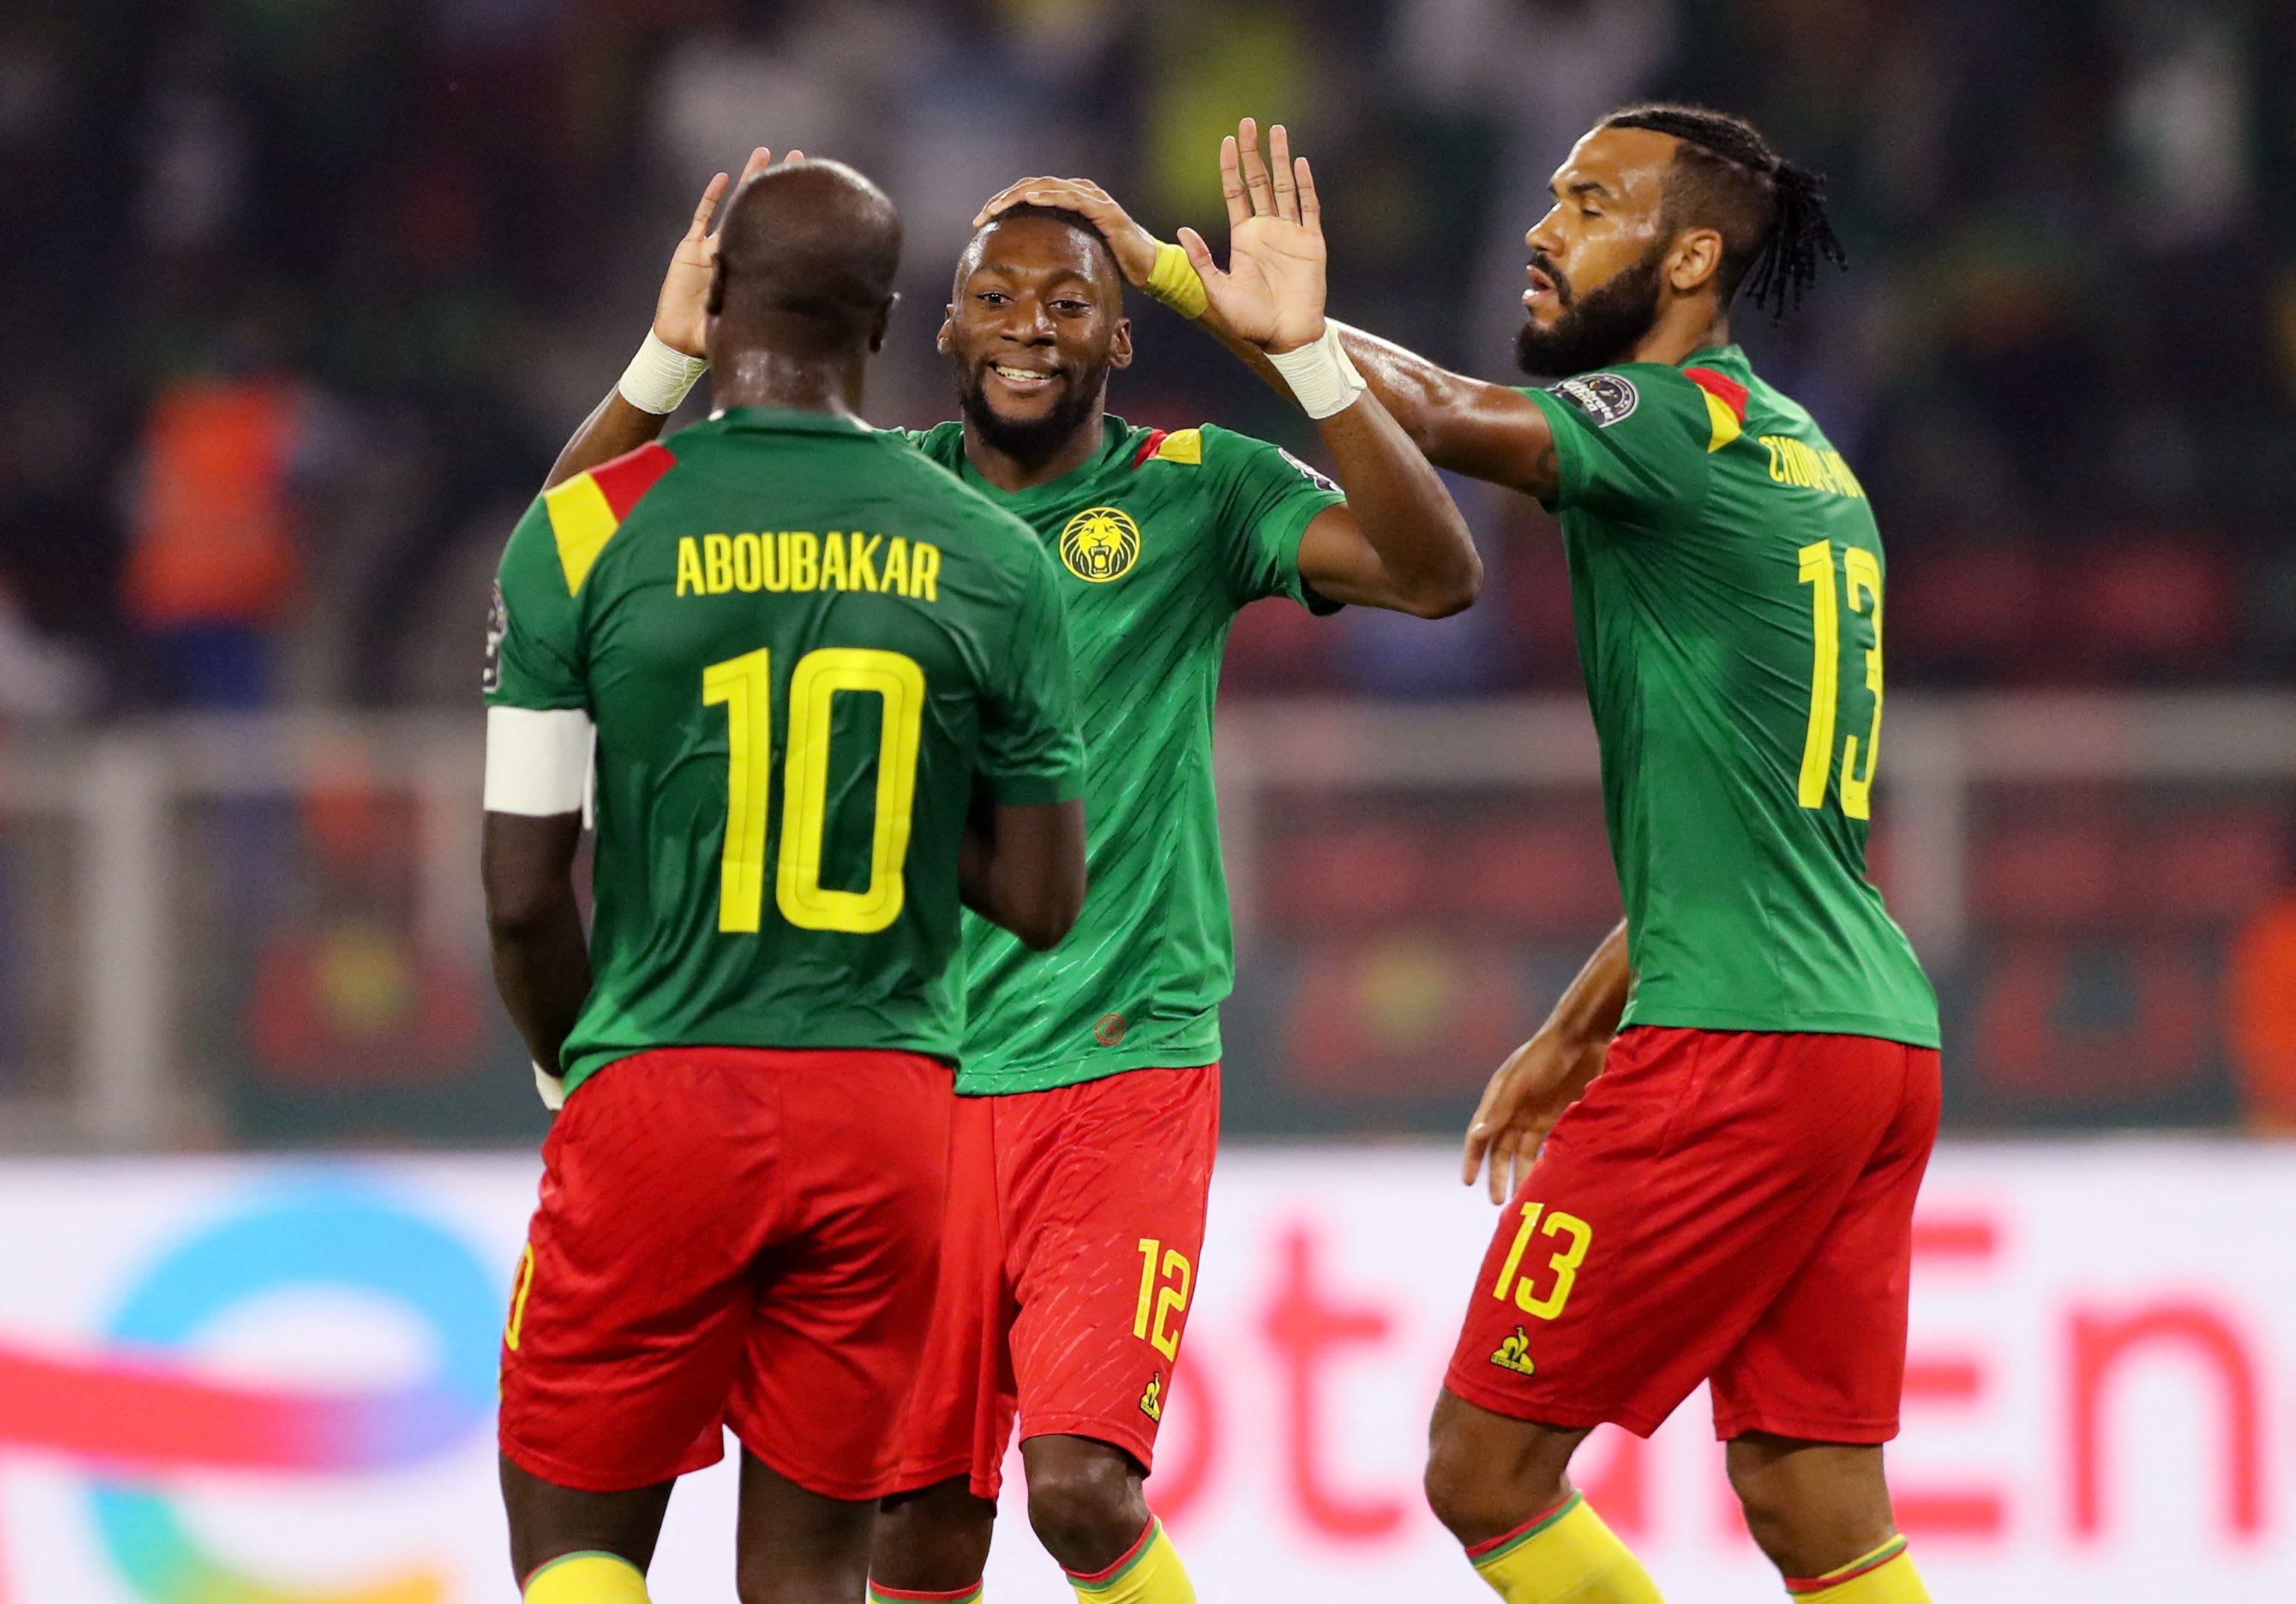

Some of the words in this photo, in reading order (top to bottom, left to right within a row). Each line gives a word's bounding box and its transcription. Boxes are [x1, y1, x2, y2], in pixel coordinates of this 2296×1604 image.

[676, 530, 941, 602] ABOUBAKAR
[1798, 538, 1883, 820] 13
[703, 647, 926, 934] 10
[1133, 1237, 1191, 1363] 12
[1493, 1201, 1592, 1321] 13
